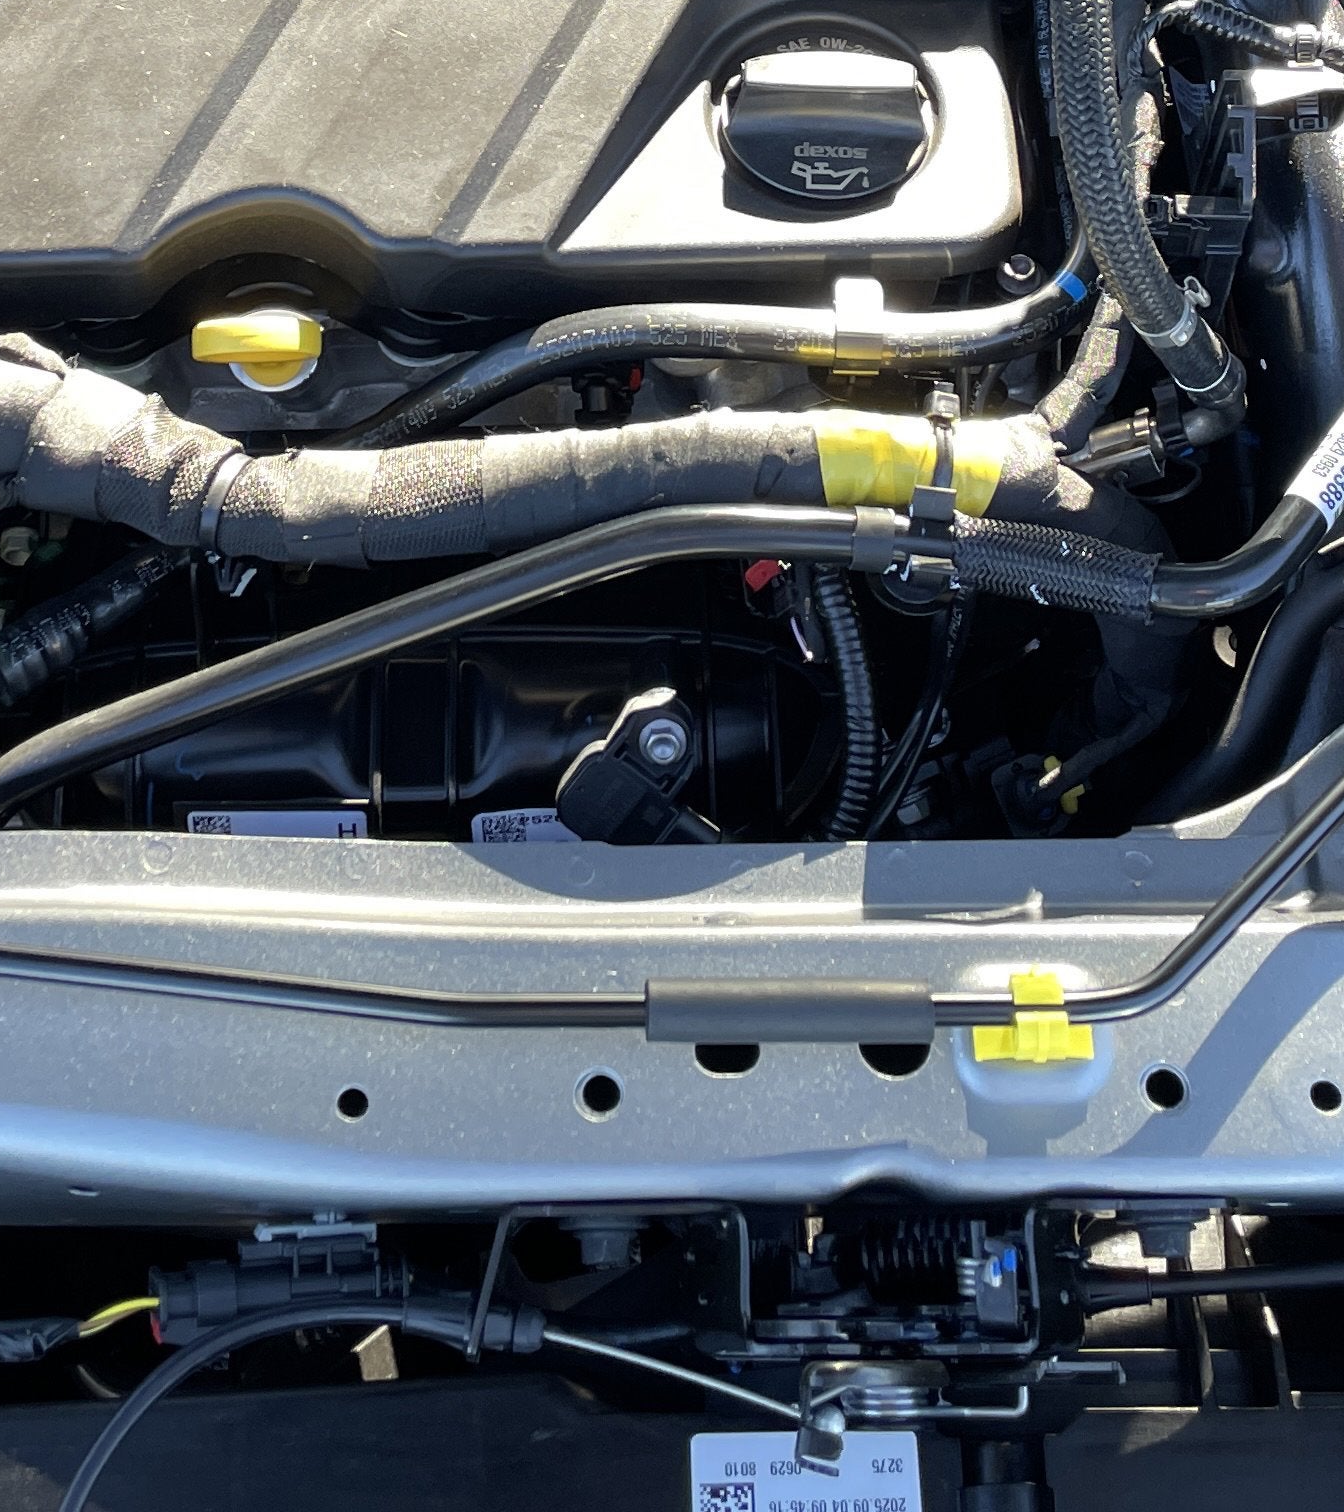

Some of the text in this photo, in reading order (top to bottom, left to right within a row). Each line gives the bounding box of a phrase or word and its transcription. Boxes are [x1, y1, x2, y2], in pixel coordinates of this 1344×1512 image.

[776, 37, 811, 54] SAE
[793, 141, 870, 159] dexos
[647, 320, 689, 347] 525
[699, 323, 740, 349] MEX
[1311, 455, 1339, 479] 0953
[338, 822, 358, 838] H
[724, 1457, 904, 1477] 3275 0629 8010
